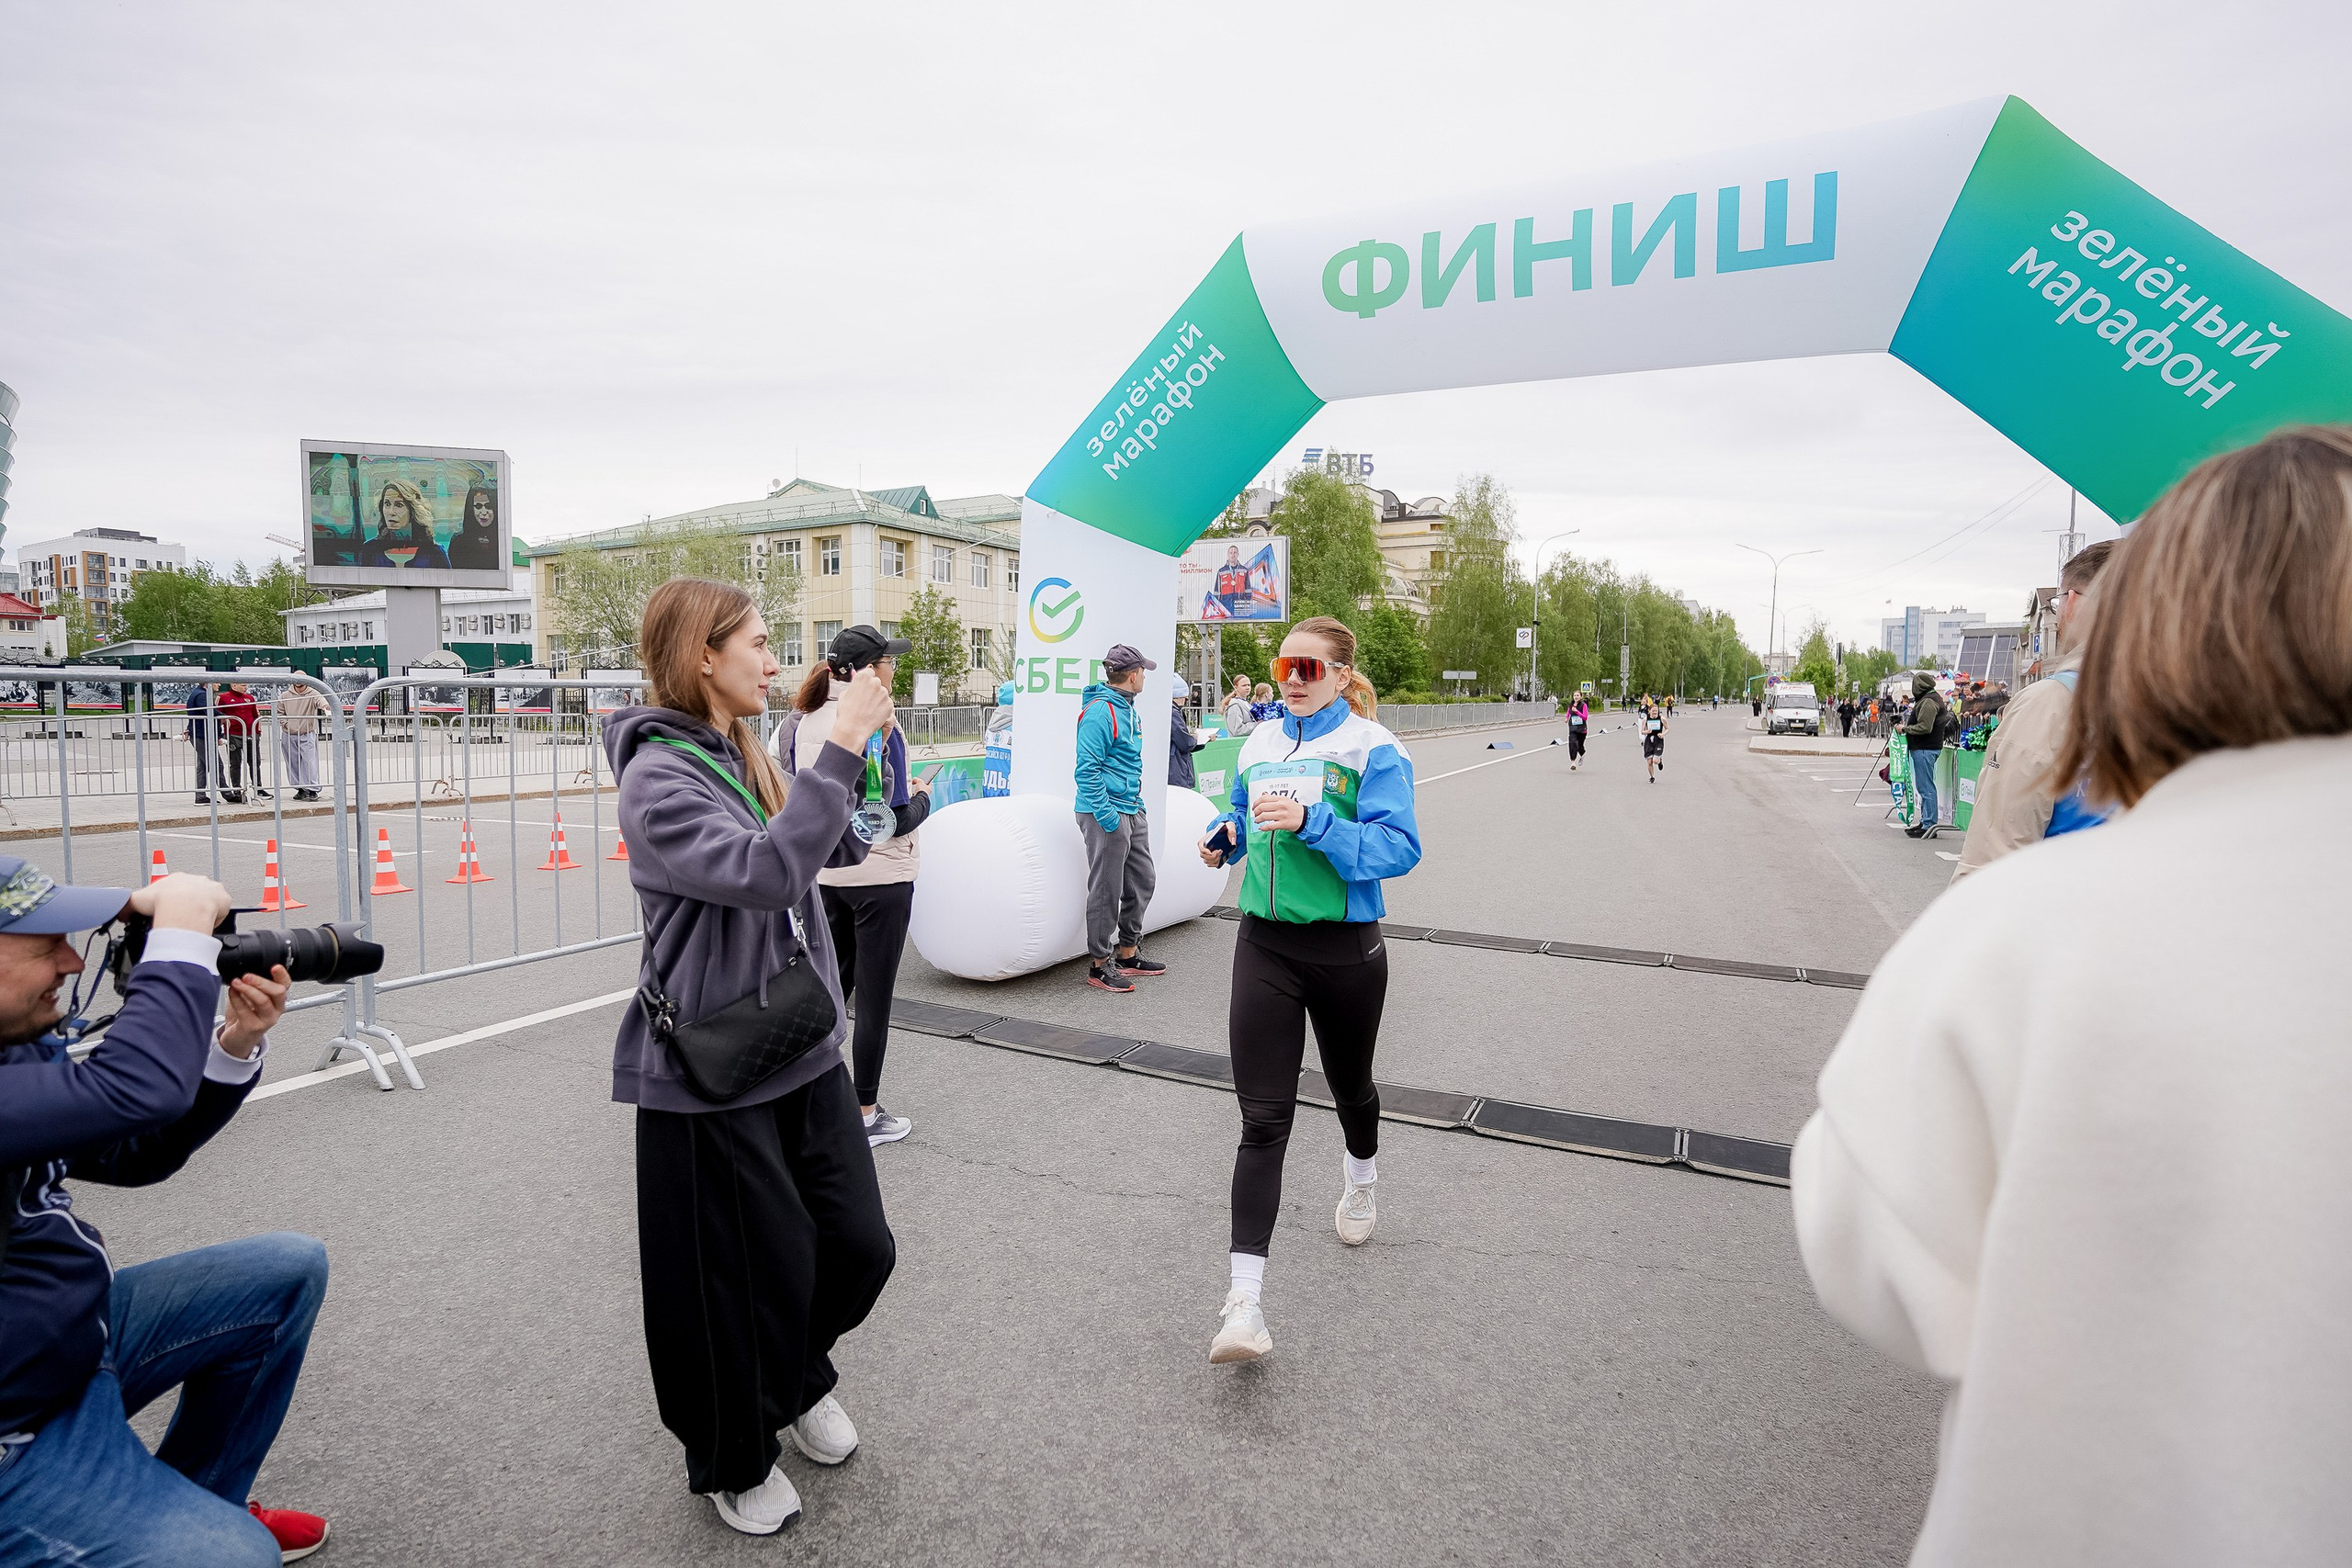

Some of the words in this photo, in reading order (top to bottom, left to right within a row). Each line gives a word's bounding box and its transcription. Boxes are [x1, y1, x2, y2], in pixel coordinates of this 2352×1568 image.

[1322, 171, 1838, 319] ФИНИШ
[2050, 210, 2290, 370] зелёный
[1086, 321, 1204, 457] зелёный
[2007, 246, 2236, 410] марафон
[1102, 344, 1227, 480] марафон
[1327, 454, 1374, 476] ВТБ
